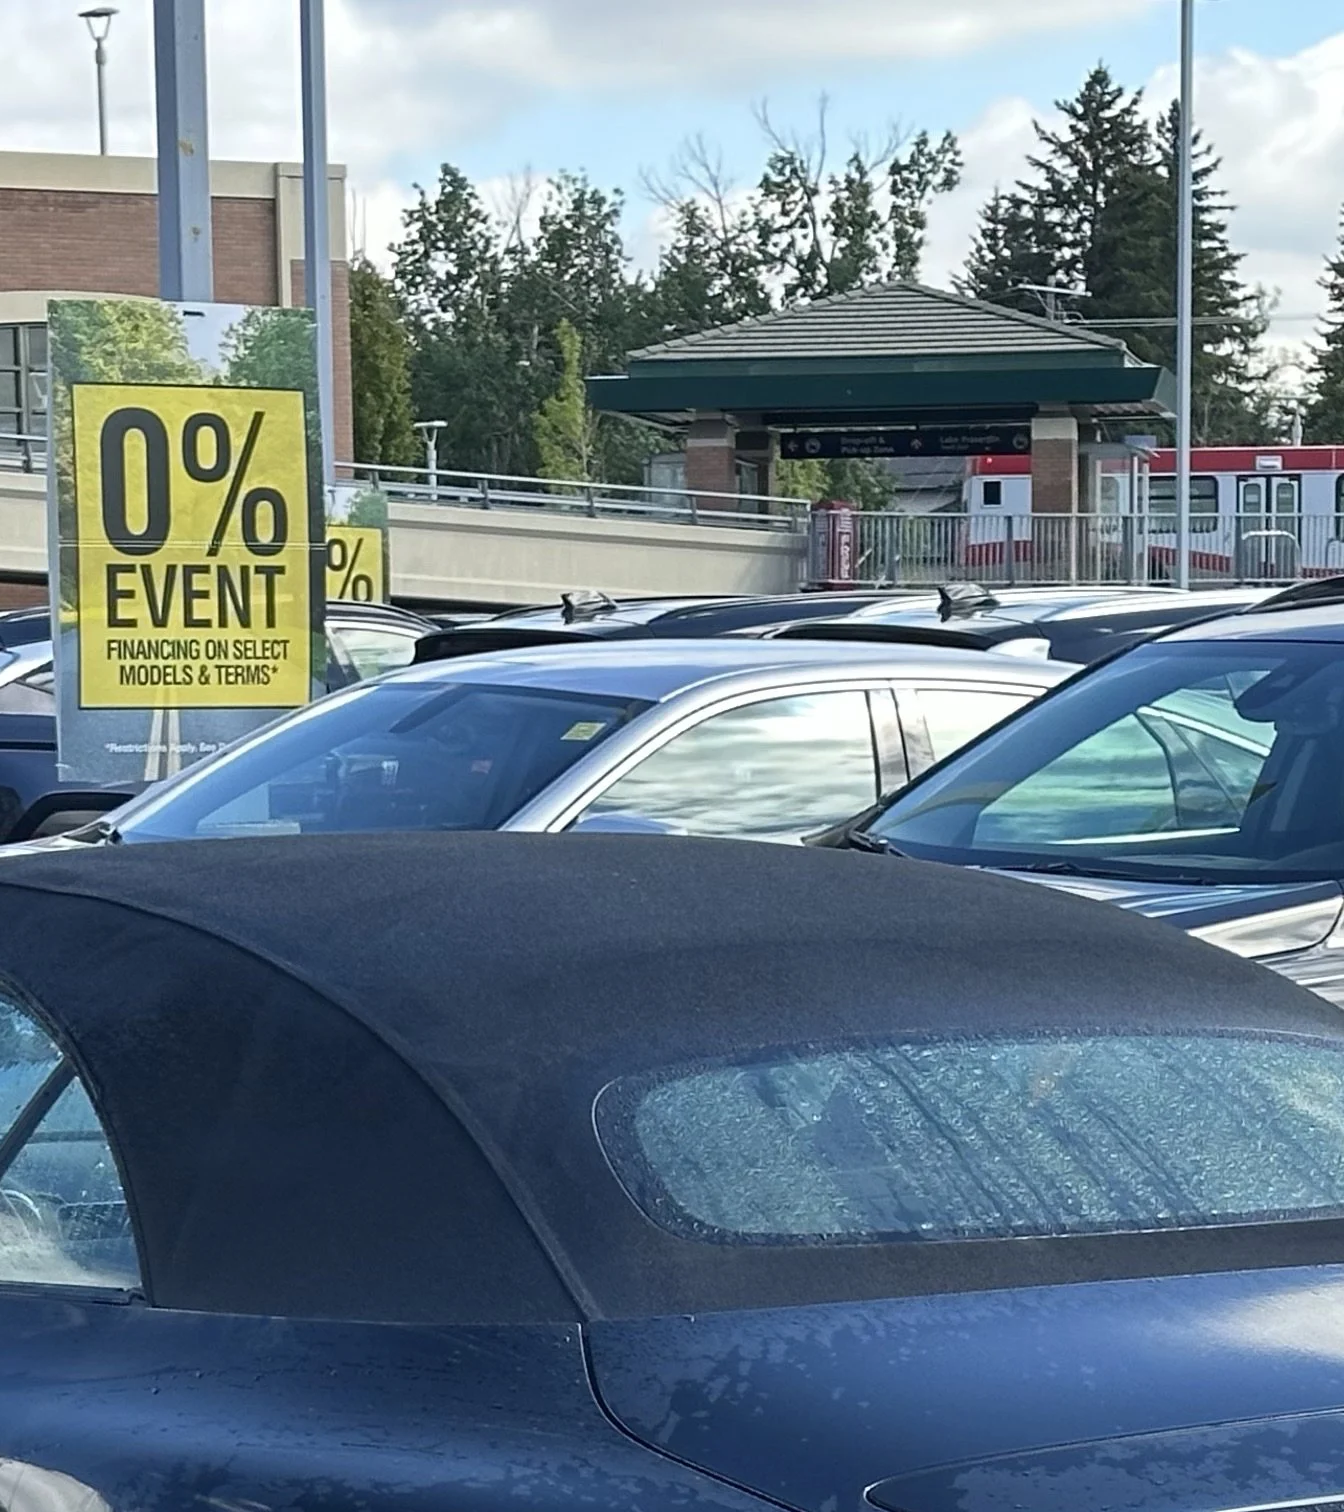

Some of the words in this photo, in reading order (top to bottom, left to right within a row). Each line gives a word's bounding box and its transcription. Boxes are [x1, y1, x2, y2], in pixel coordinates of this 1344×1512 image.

[100, 407, 288, 557] 0%
[106, 564, 286, 628] EVENT
[106, 639, 200, 660] FINANCING
[205, 640, 228, 660] ON
[233, 640, 290, 660] SELECT
[119, 664, 193, 686] MODELS
[198, 665, 211, 685] &
